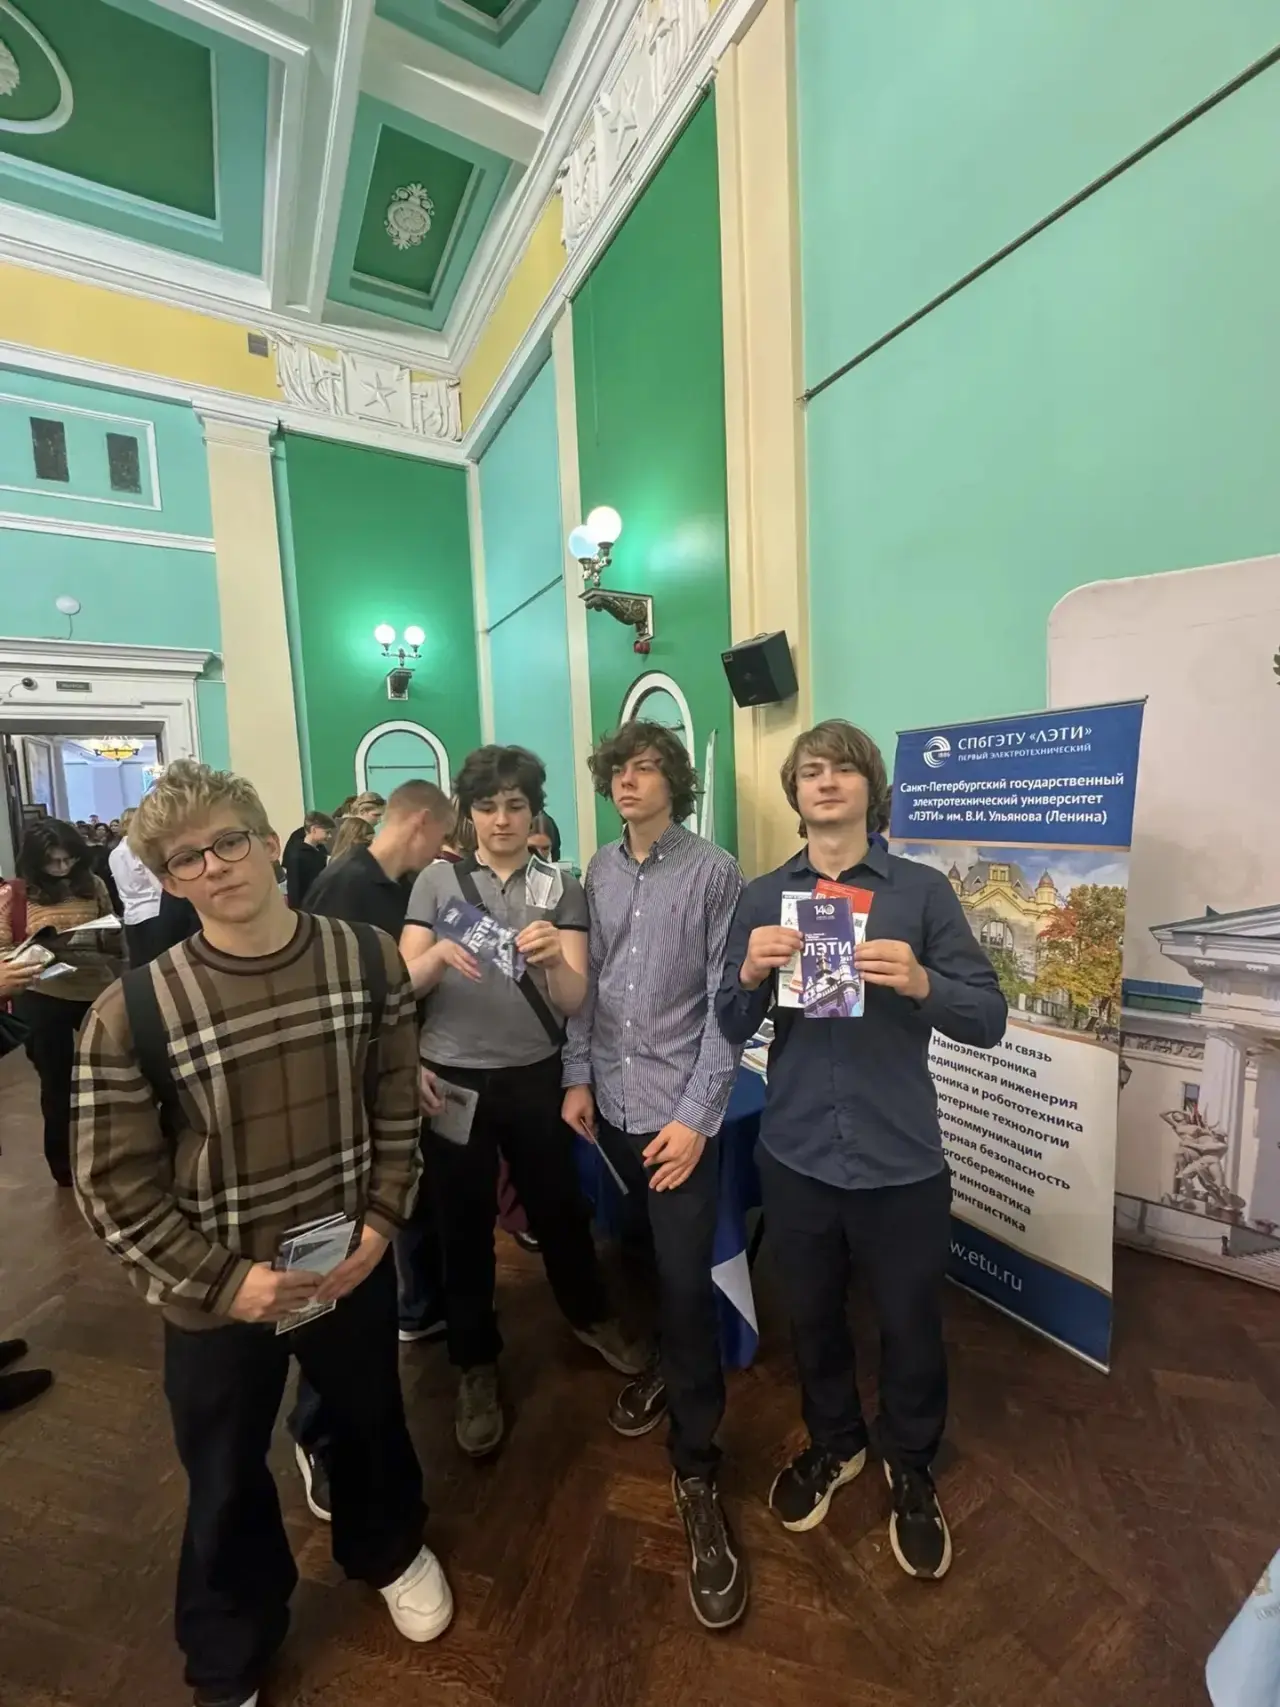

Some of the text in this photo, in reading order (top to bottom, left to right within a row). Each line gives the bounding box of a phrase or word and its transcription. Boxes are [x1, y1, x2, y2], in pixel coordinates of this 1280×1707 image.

[958, 726, 1092, 750] СПбГЭТУ «ЛЭТИ»
[958, 752, 988, 761] ПЕРВЫЙ
[990, 743, 1091, 759] ЭЛЕКТРОТЕХНИЧЕСКИЙ
[900, 773, 1124, 793] Санкт-Петербургский государственный
[913, 794, 1103, 808] электротехнический университет
[908, 811, 944, 821] «ЛЭТИ»
[965, 811, 986, 821] В.И.
[989, 810, 1042, 822] Ульянова
[1046, 810, 1107, 825] (Ленина)
[803, 941, 852, 956] ЛЭТИ
[933, 1035, 1037, 1079] Наноэлектроника
[1005, 1041, 1013, 1051] и
[1015, 1044, 1052, 1063] связь
[1000, 1077, 1078, 1110] инженерия
[972, 1086, 979, 1096] и
[982, 1090, 1084, 1133] робототехника
[992, 1112, 1070, 1149] технологии
[979, 1143, 1071, 1190] безопасность
[959, 1173, 1031, 1216] инноватика
